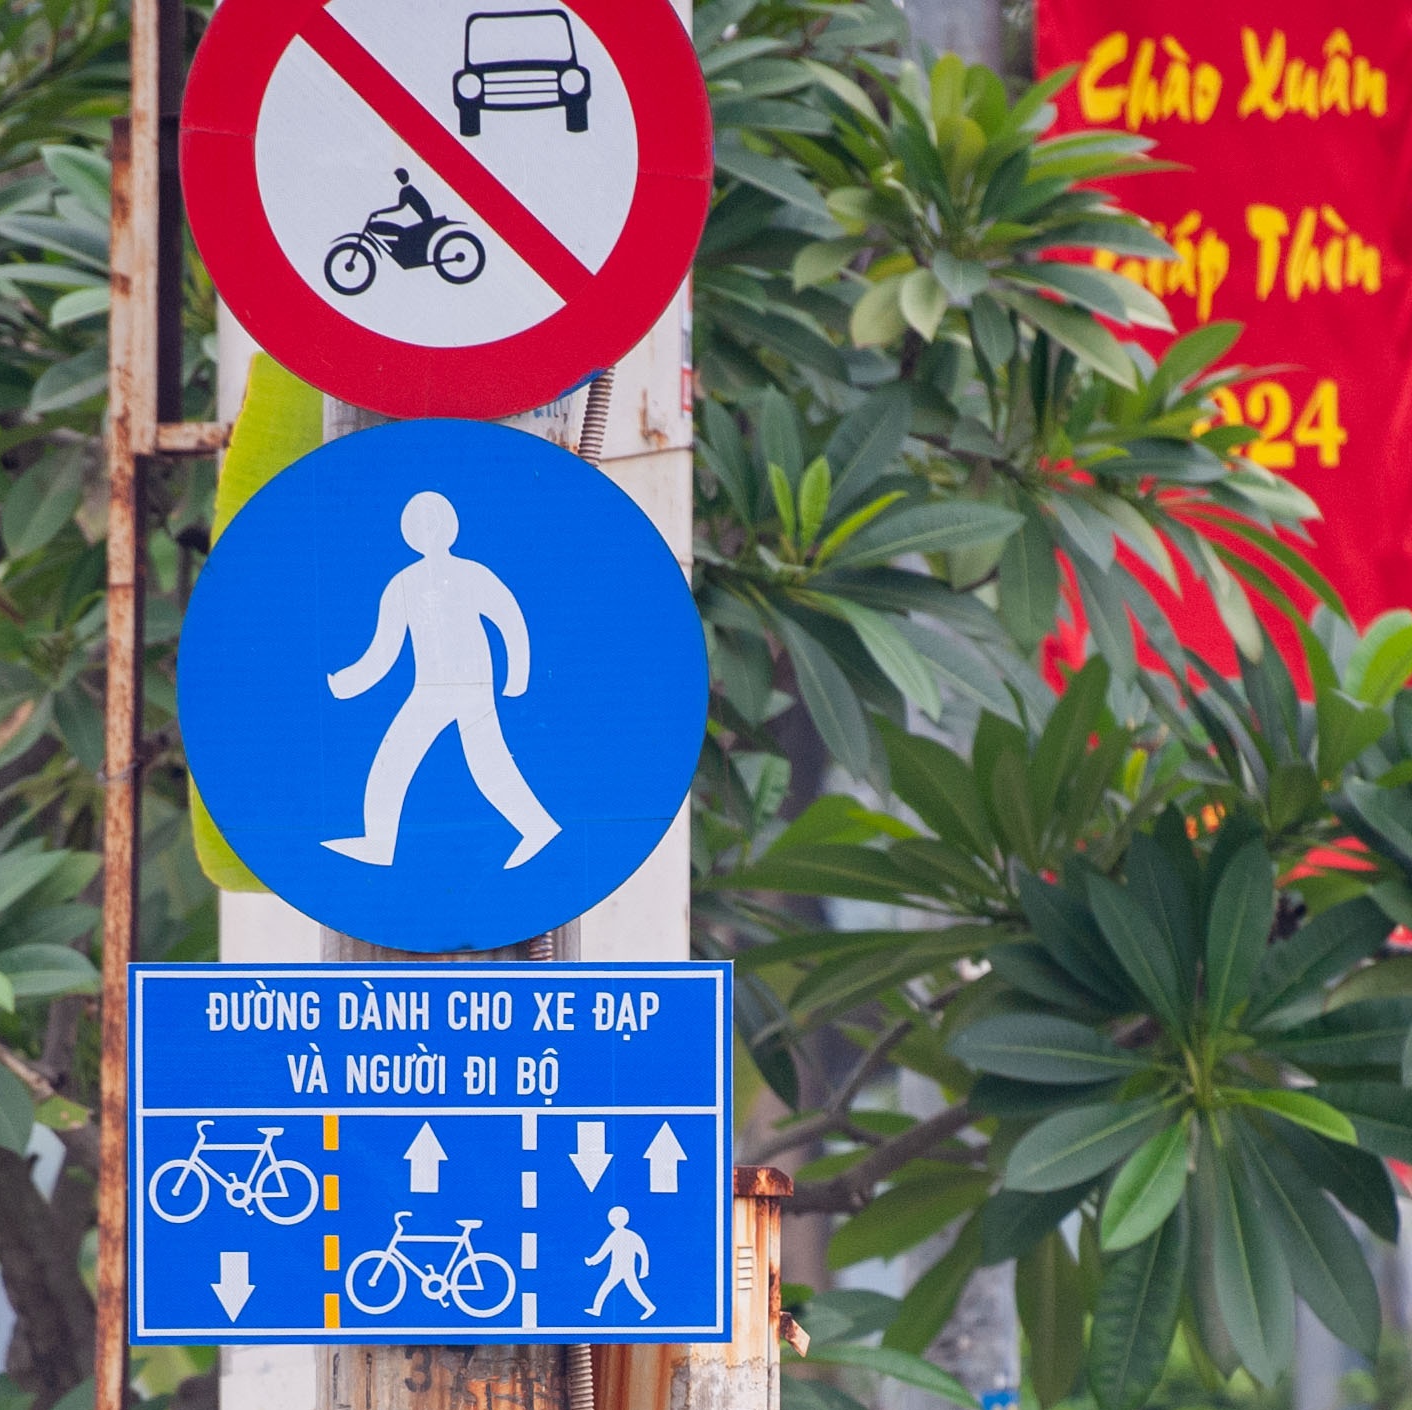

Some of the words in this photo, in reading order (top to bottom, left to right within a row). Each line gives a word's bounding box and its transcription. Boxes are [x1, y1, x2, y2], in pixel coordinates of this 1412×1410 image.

[1078, 30, 1223, 131] Chào
[1238, 26, 1388, 120] Xuân
[1091, 209, 1230, 325] iáp
[1245, 203, 1382, 302] Thìn
[205, 980, 320, 1032] ĐƯỜNG
[339, 980, 430, 1031] DÀNH
[447, 991, 513, 1031] CHO
[532, 992, 576, 1031] XE
[592, 991, 661, 1041] ĐẠP
[286, 1043, 329, 1094] VÀ
[346, 1043, 447, 1095] NGƯỜI
[463, 1055, 497, 1096] ĐI
[516, 1048, 560, 1105] BỘ
